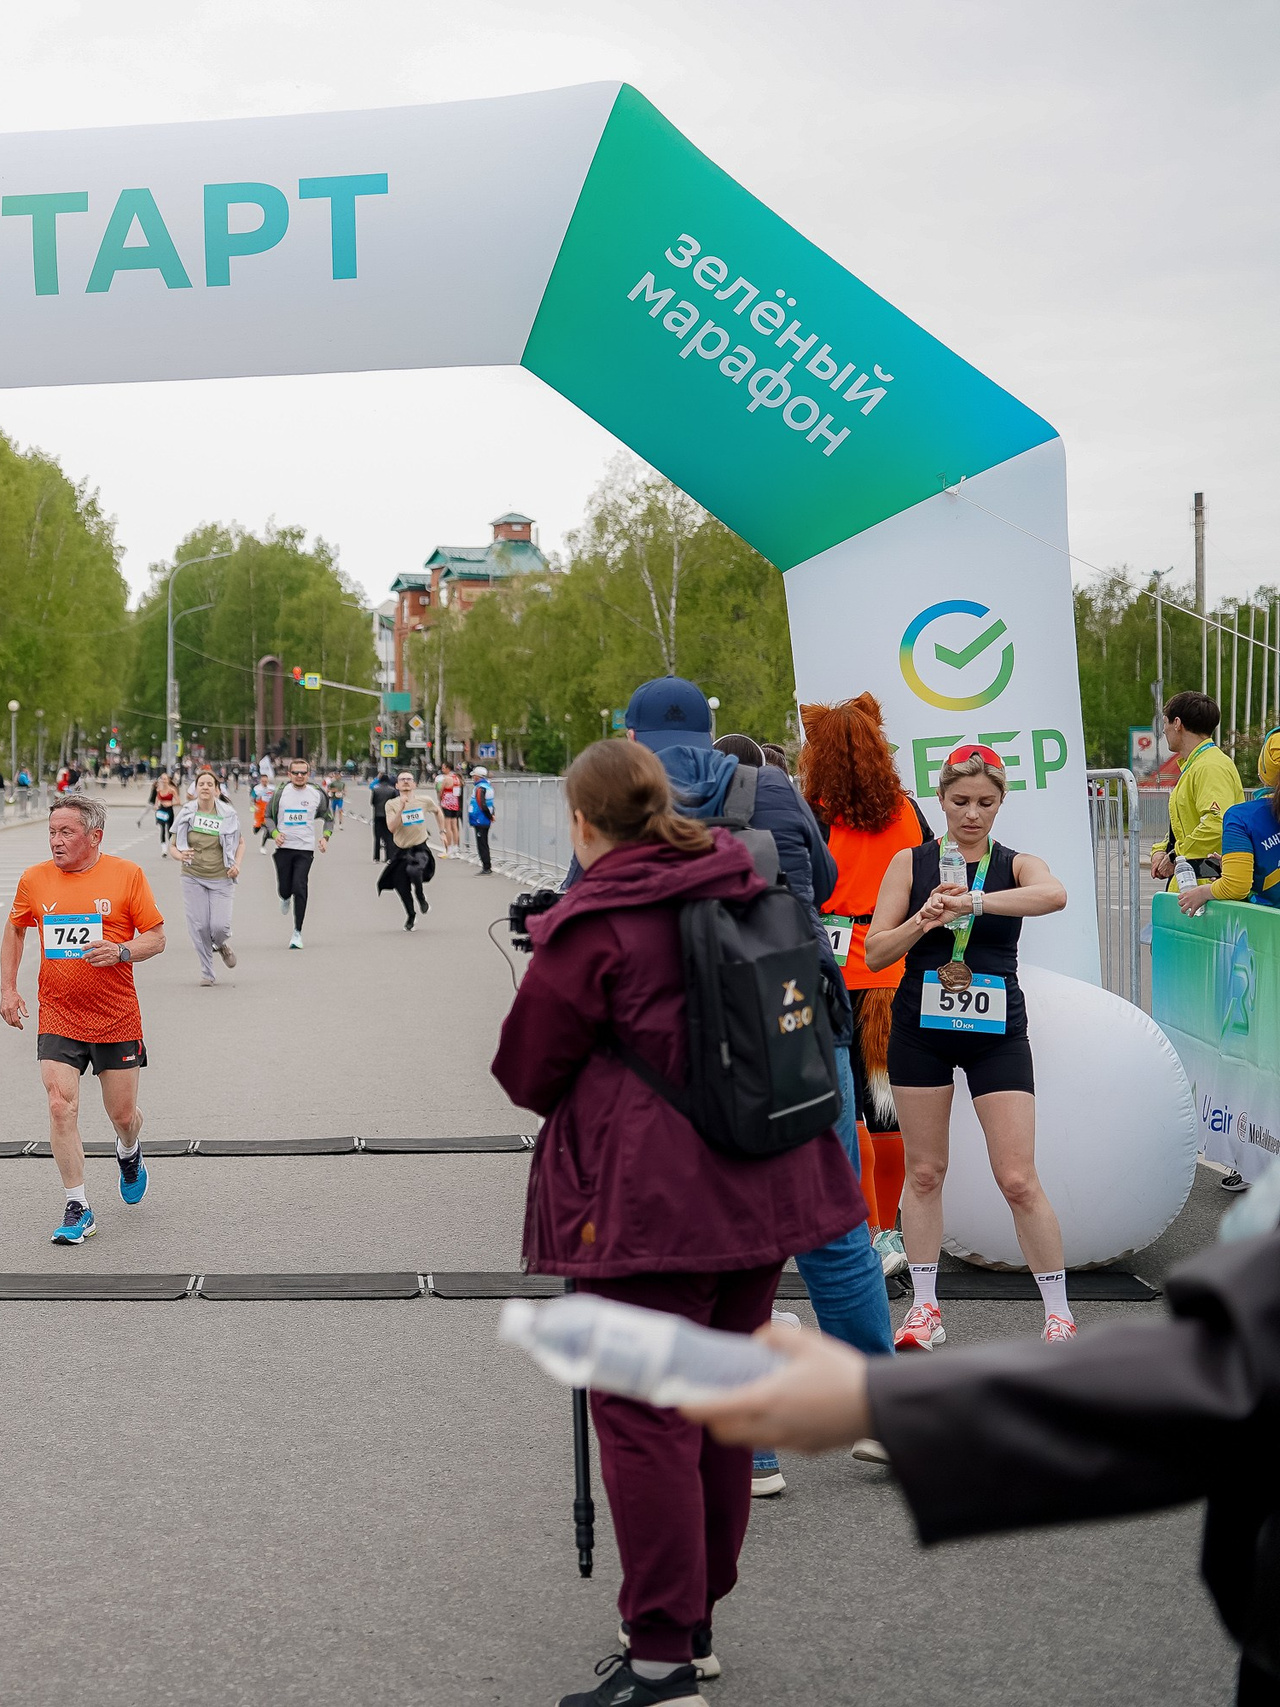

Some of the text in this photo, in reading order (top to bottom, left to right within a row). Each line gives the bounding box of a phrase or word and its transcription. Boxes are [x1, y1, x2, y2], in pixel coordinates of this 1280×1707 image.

[664, 232, 895, 417] зелёный
[626, 270, 852, 458] марафон
[890, 728, 1068, 799] БЕР
[198, 818, 220, 830] 1423
[54, 927, 91, 946] 742
[939, 988, 990, 1014] 590
[1202, 1094, 1233, 1135] Uair
[1038, 1274, 1064, 1282] cep
